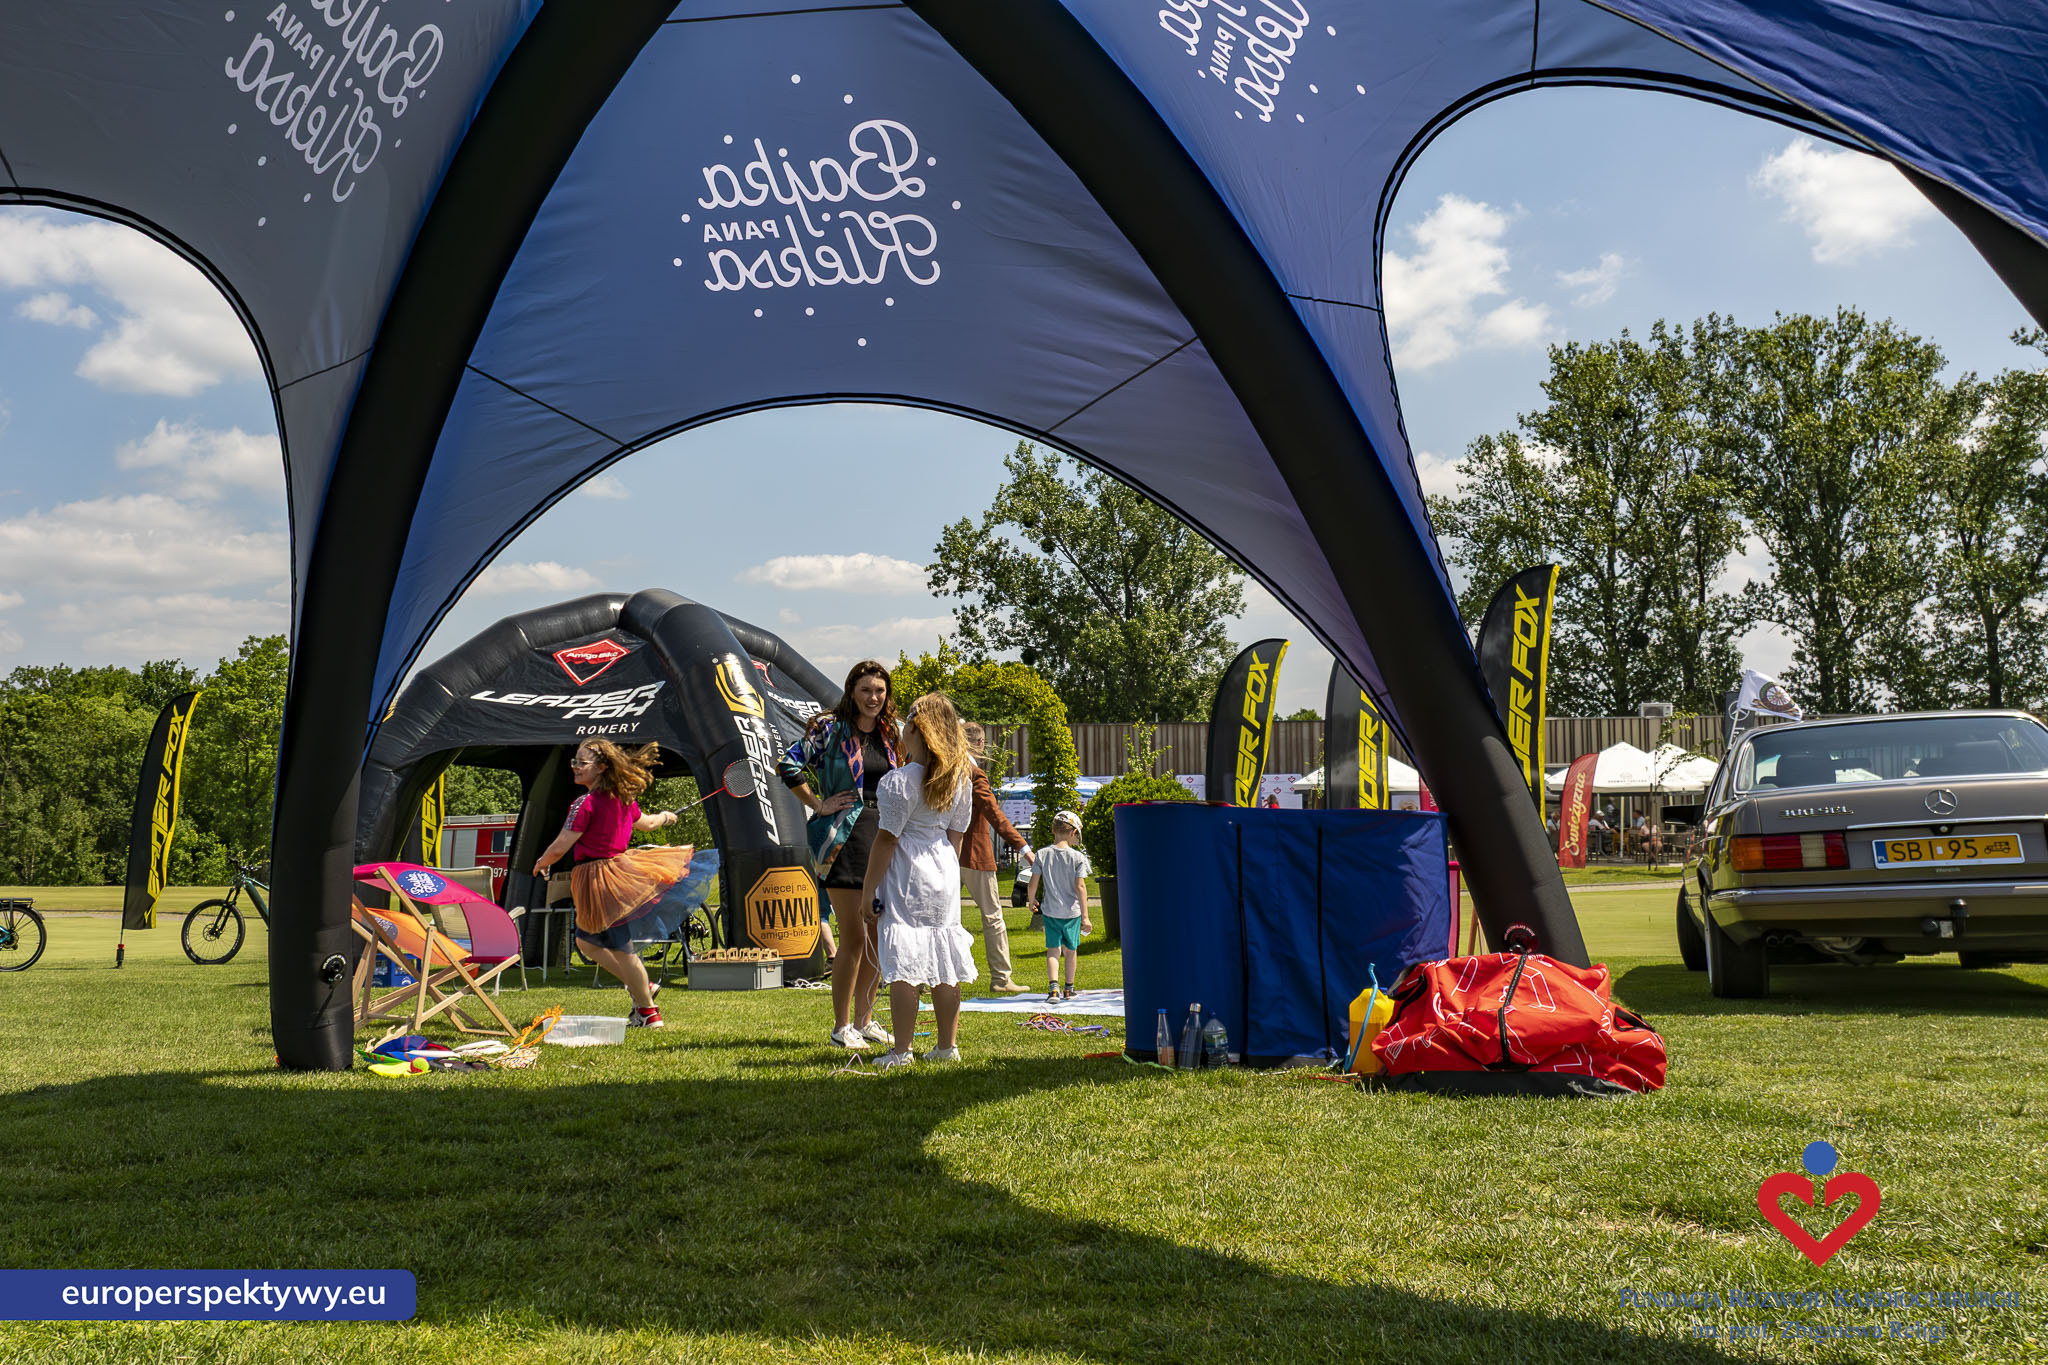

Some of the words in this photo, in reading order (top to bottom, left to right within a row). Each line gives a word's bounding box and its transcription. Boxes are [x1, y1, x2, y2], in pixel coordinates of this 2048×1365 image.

[1511, 583, 1540, 681] FOX
[470, 681, 666, 708] LEADER
[1243, 650, 1270, 730] FOX
[162, 704, 185, 776] FOX
[575, 721, 641, 735] ROWERY
[733, 715, 781, 846] LEADER
[1948, 838, 1978, 860] 95
[762, 883, 794, 895] więcej
